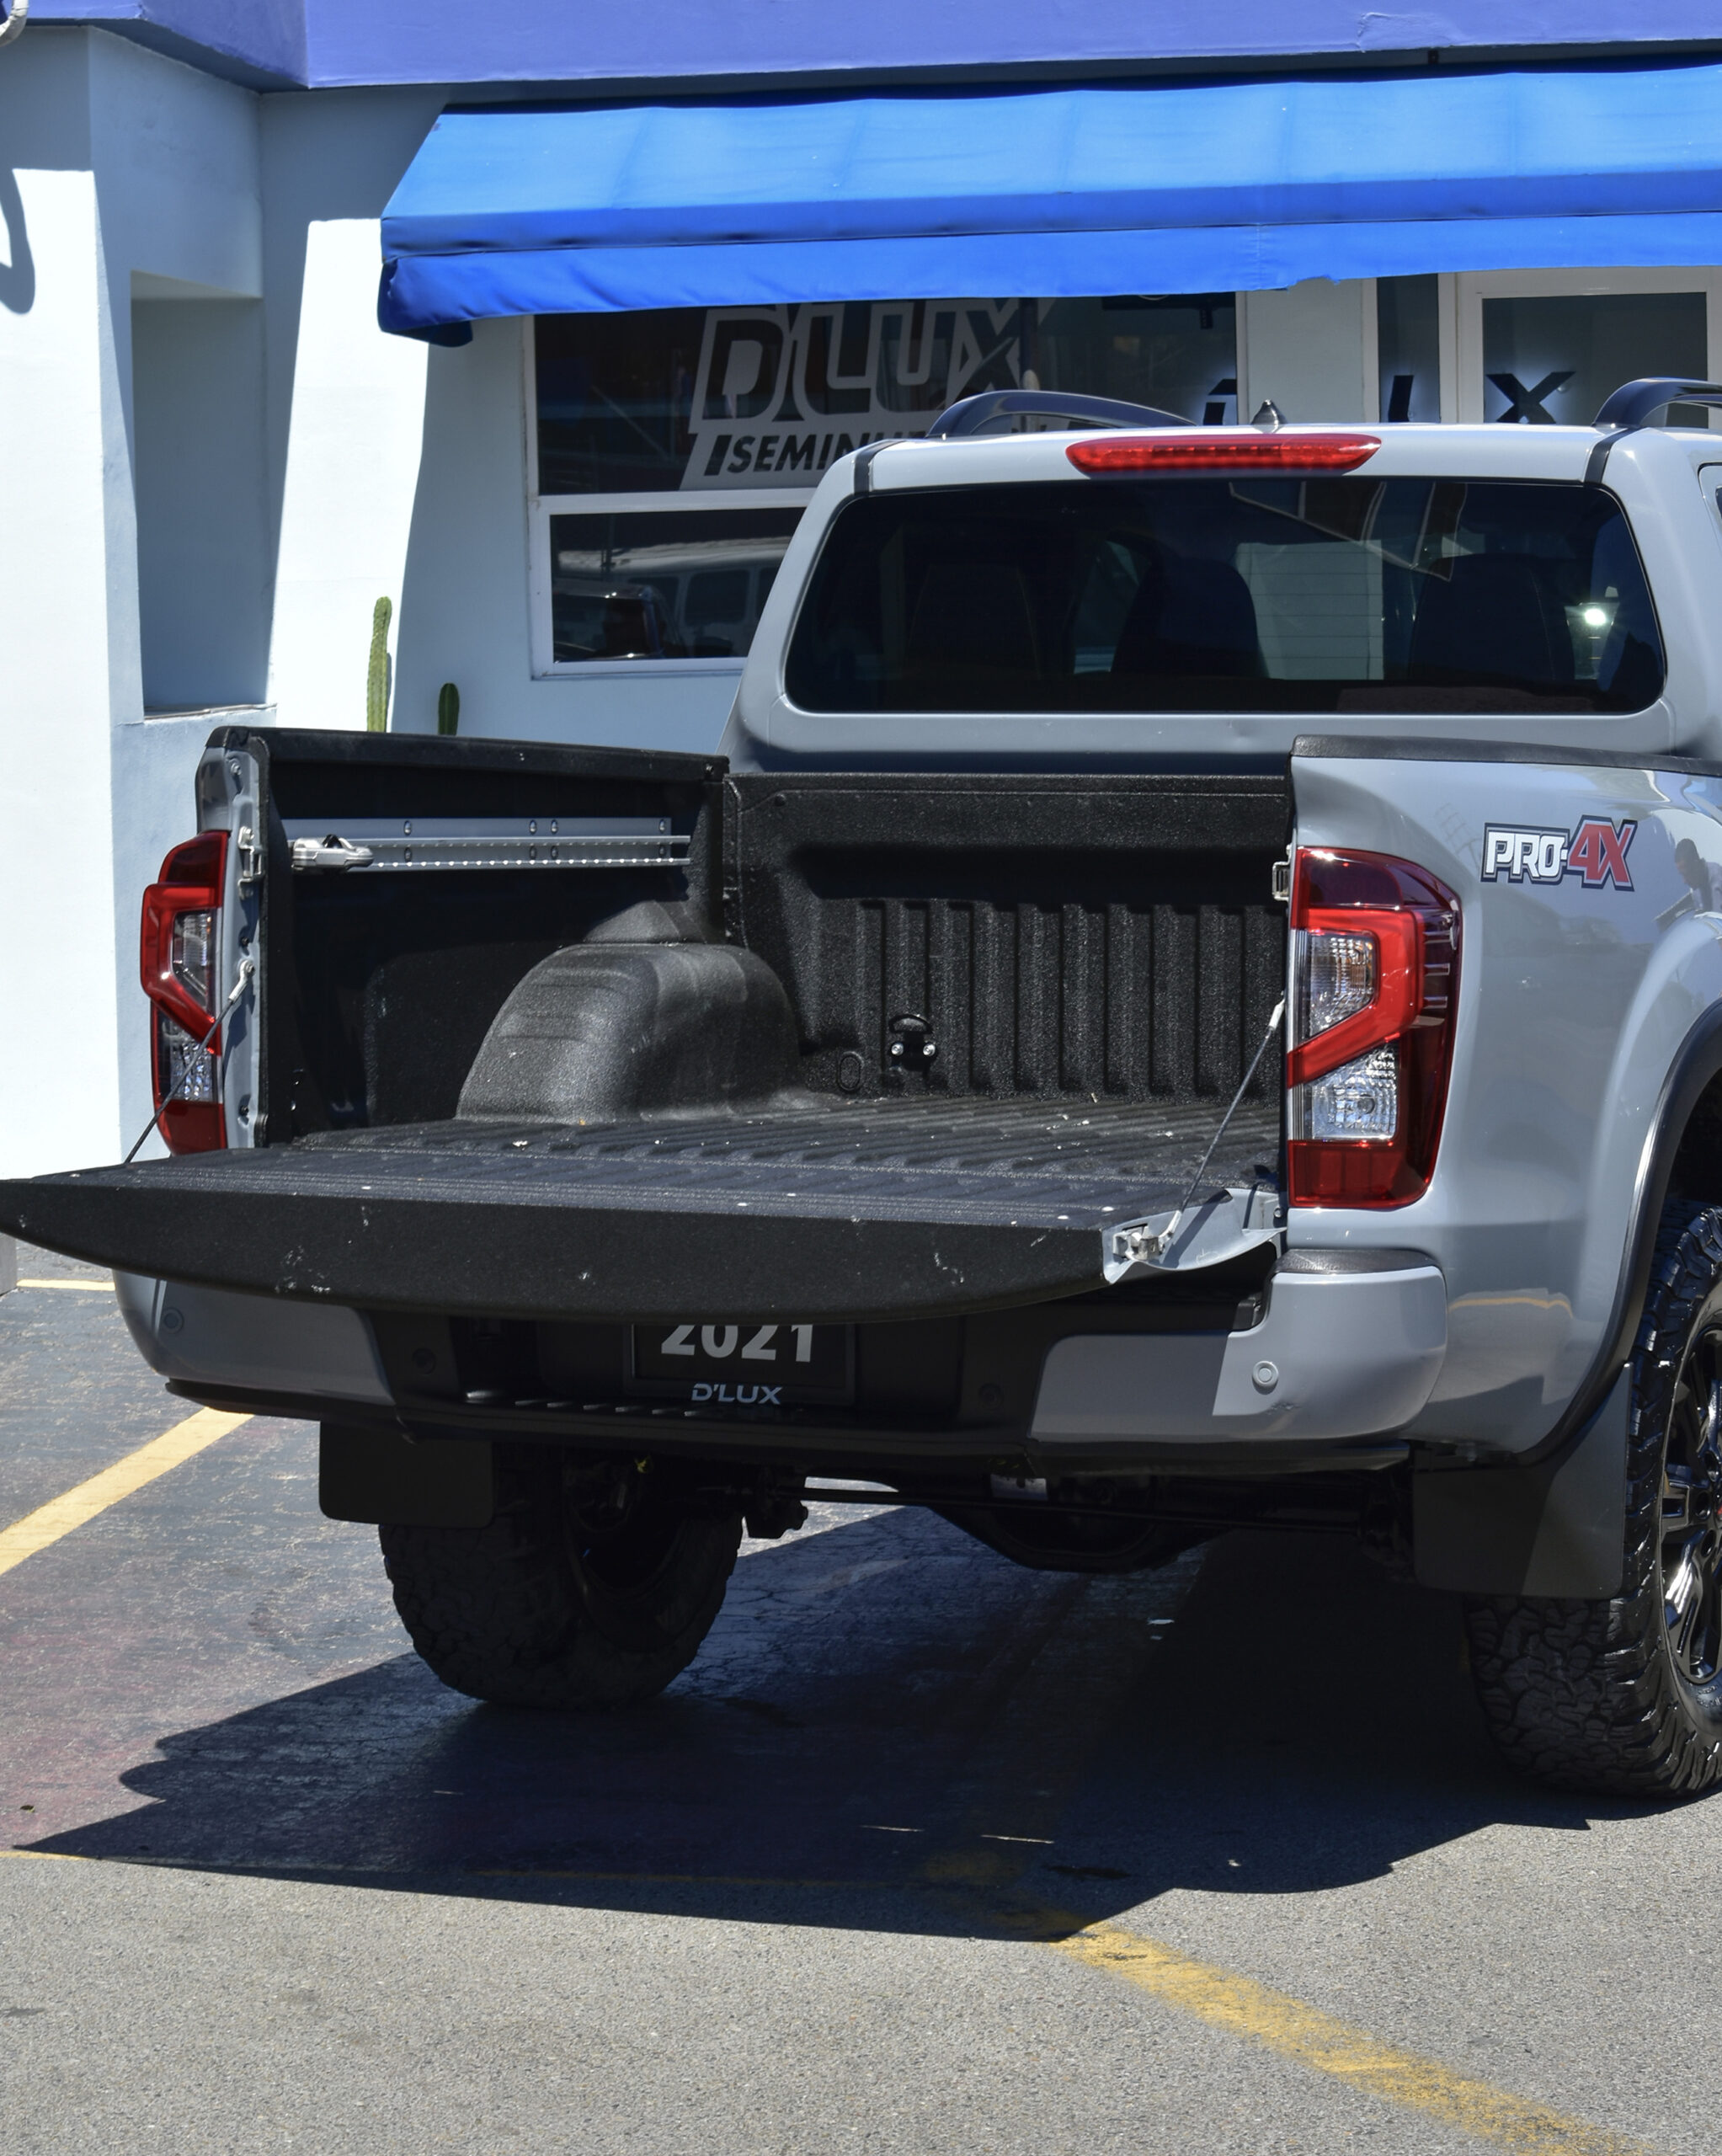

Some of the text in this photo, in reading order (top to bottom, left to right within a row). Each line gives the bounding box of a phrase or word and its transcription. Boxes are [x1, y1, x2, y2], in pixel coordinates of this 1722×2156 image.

[1480, 814, 1638, 892] PRO-4X
[661, 1325, 813, 1363] 2021
[690, 1383, 783, 1405] D'LUX
